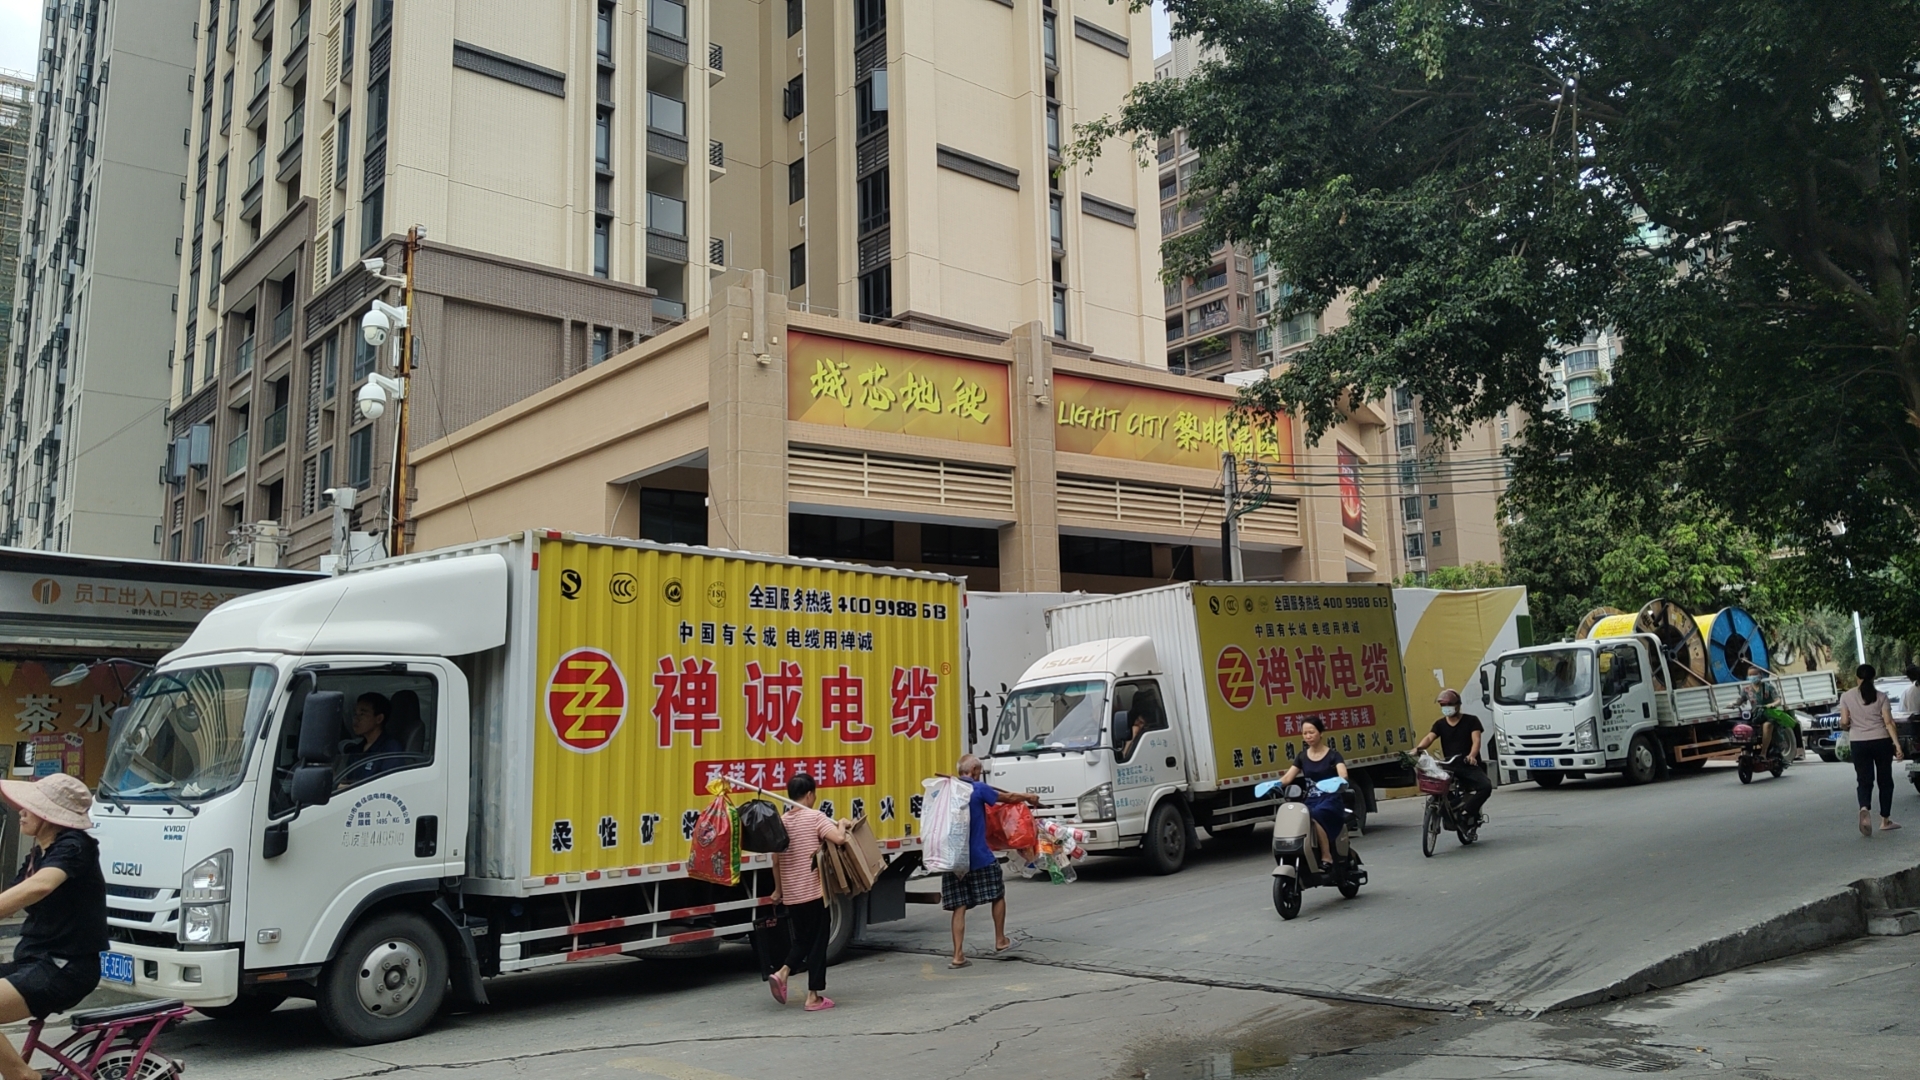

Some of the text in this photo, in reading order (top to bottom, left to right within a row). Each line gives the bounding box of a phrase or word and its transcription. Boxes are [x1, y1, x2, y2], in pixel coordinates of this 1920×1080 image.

[810, 358, 990, 424] 城芯地段
[1058, 400, 1122, 432] LIGHT
[1126, 412, 1169, 440] CITY
[750, 585, 833, 614] 全国服务热线
[875, 599, 917, 618] 9988
[1274, 595, 1389, 612] 全国服务热线 400 9988 613
[1041, 654, 1096, 670] ISUZU
[1256, 642, 1395, 707] 禅诚电缆
[14, 692, 116, 735] 茶水
[652, 655, 940, 748] 禅诚电缆
[1284, 707, 1372, 735] 承诺生产非标线
[1025, 785, 1055, 794] ISUZU
[111, 861, 143, 877] ISUZU
